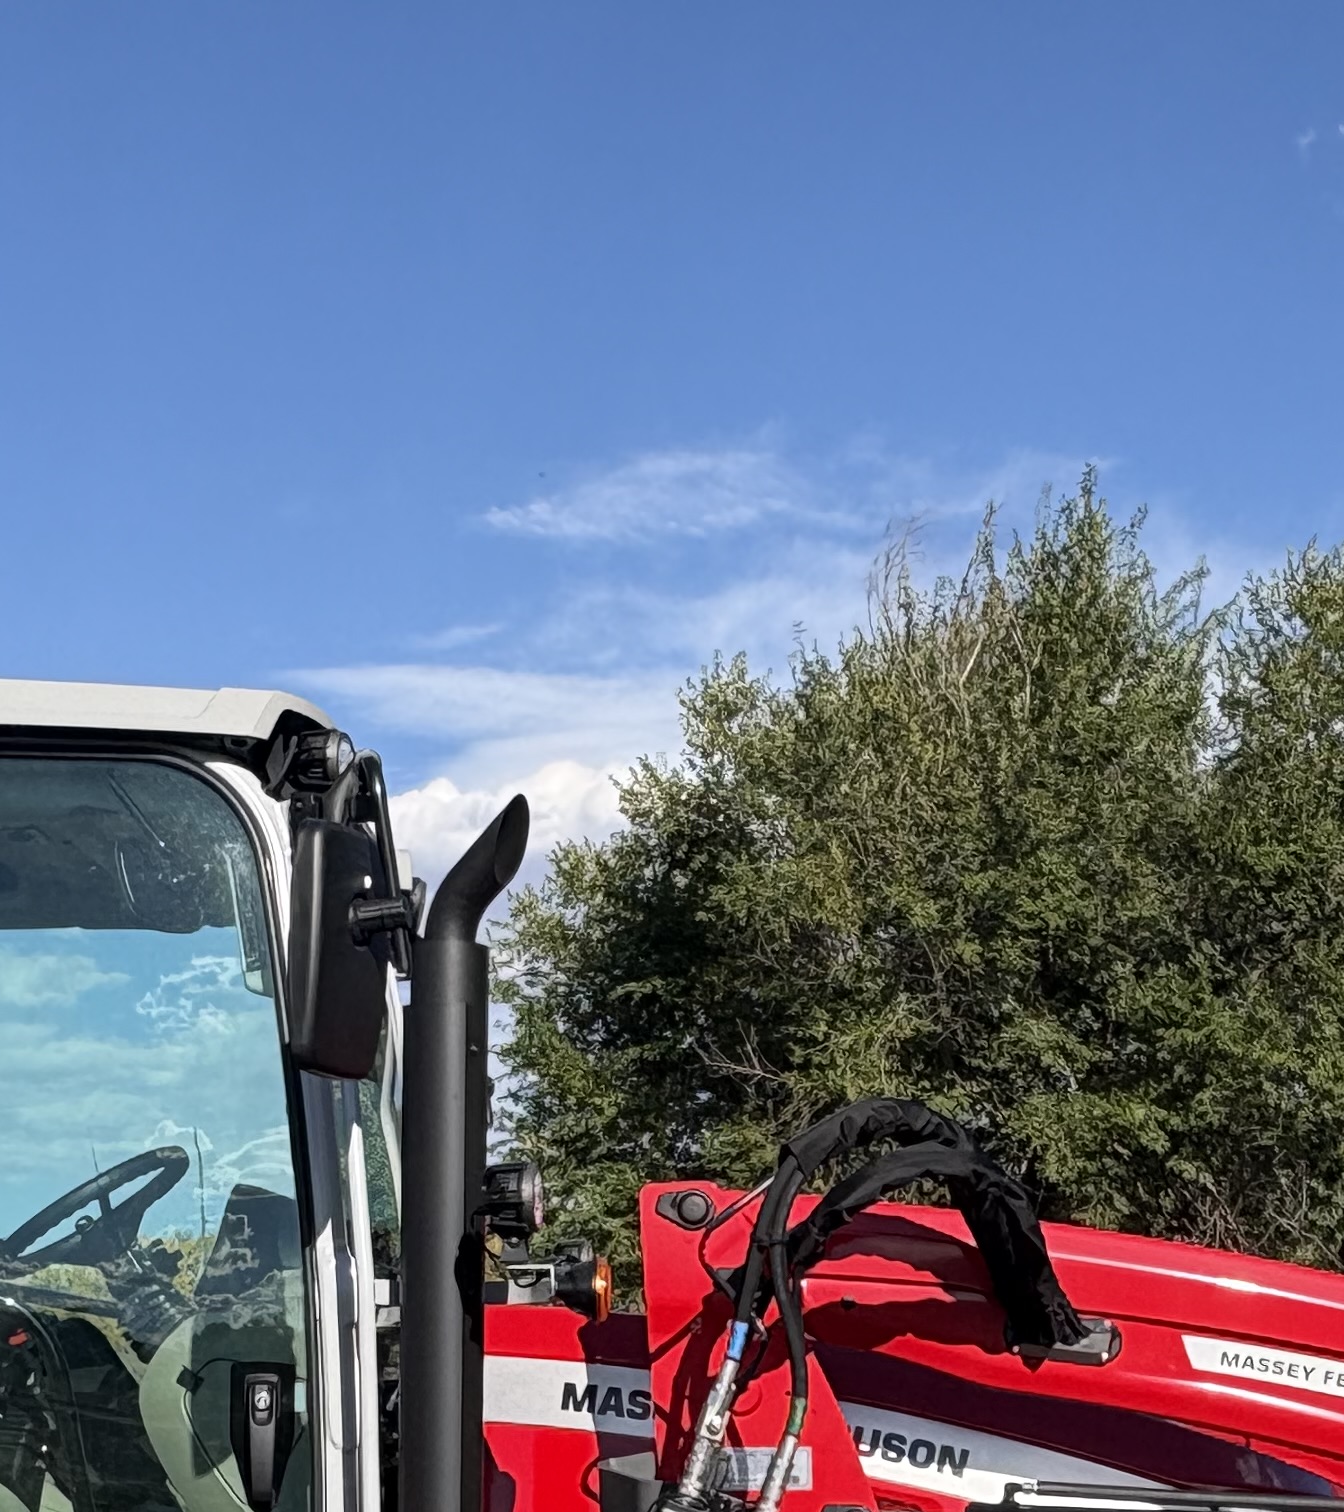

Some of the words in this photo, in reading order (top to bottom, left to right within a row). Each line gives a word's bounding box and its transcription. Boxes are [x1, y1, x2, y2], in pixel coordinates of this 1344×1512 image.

[1219, 1350, 1316, 1382] MASSEY
[561, 1381, 653, 1421] MAS
[851, 1424, 971, 1479] USON
